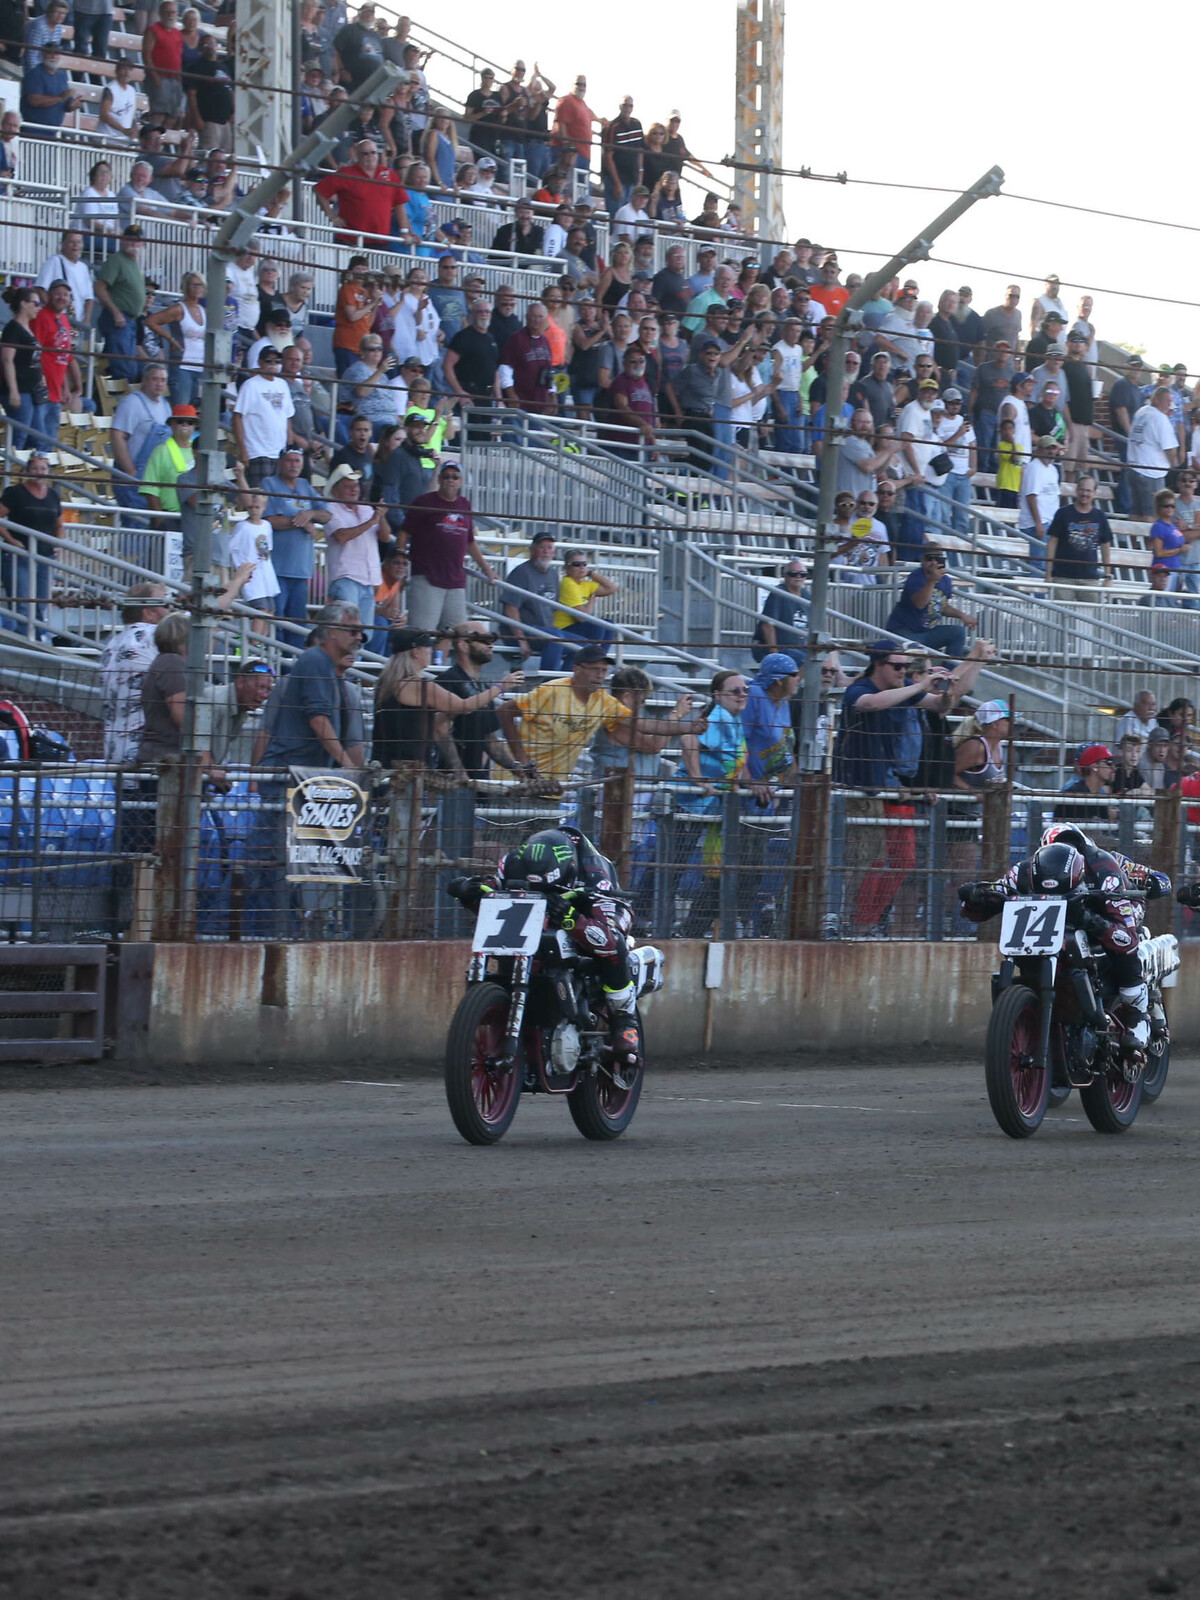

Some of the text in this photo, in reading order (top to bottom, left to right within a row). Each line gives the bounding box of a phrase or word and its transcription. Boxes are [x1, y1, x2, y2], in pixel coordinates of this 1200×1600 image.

[304, 785, 355, 802] Memphis
[546, 868, 560, 883] 69
[482, 903, 535, 949] 1
[1004, 905, 1061, 948] 14
